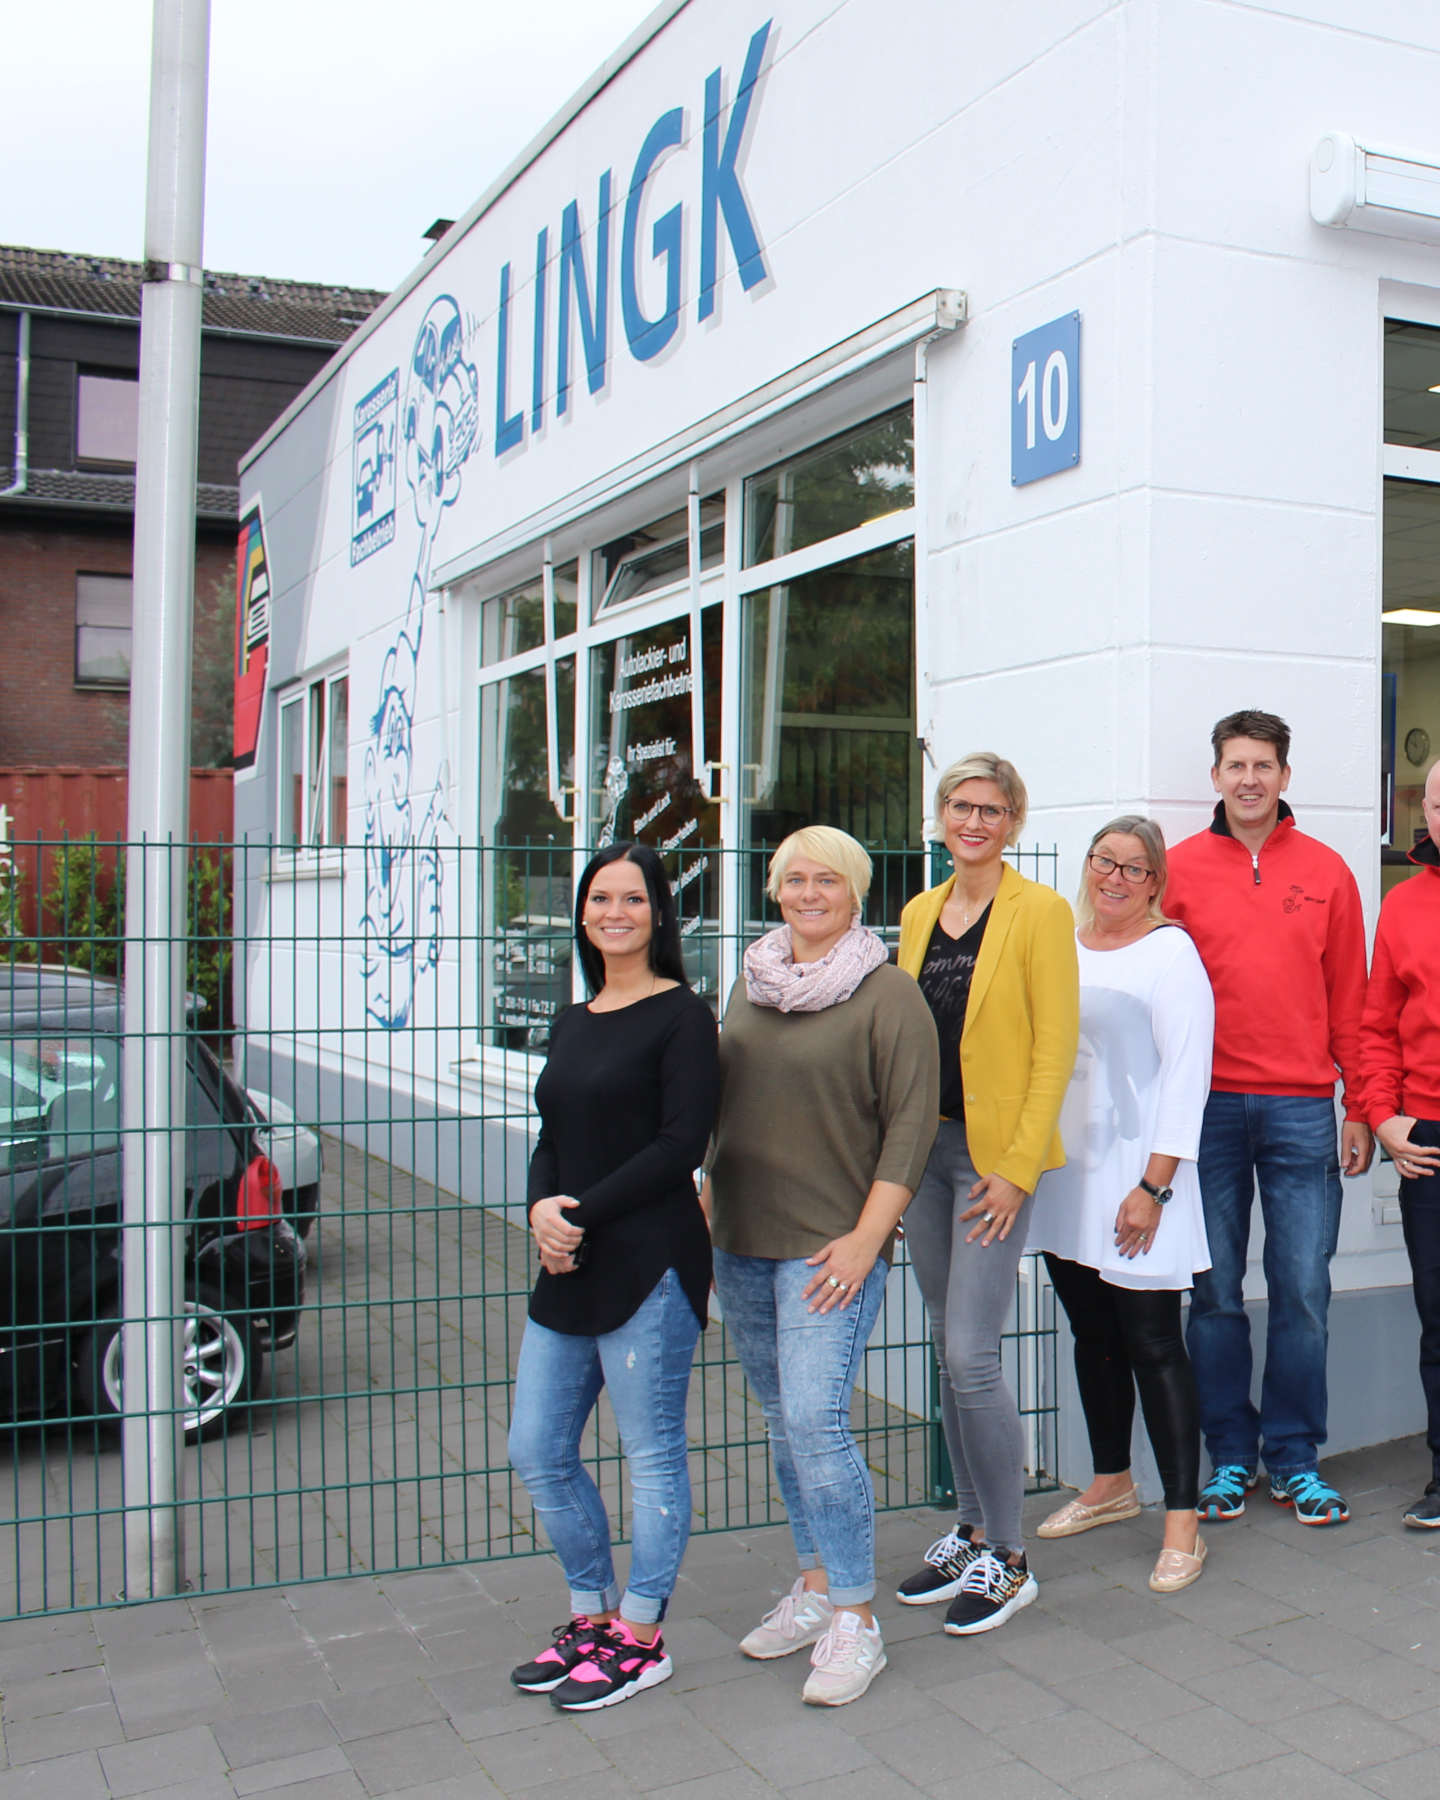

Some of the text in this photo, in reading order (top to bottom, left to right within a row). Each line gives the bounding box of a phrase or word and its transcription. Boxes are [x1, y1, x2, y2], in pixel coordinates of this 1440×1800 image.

[495, 17, 774, 459] LINGK
[1018, 350, 1069, 450] 10
[669, 636, 686, 664] und
[609, 668, 693, 713] Karosseriefachbetrie
